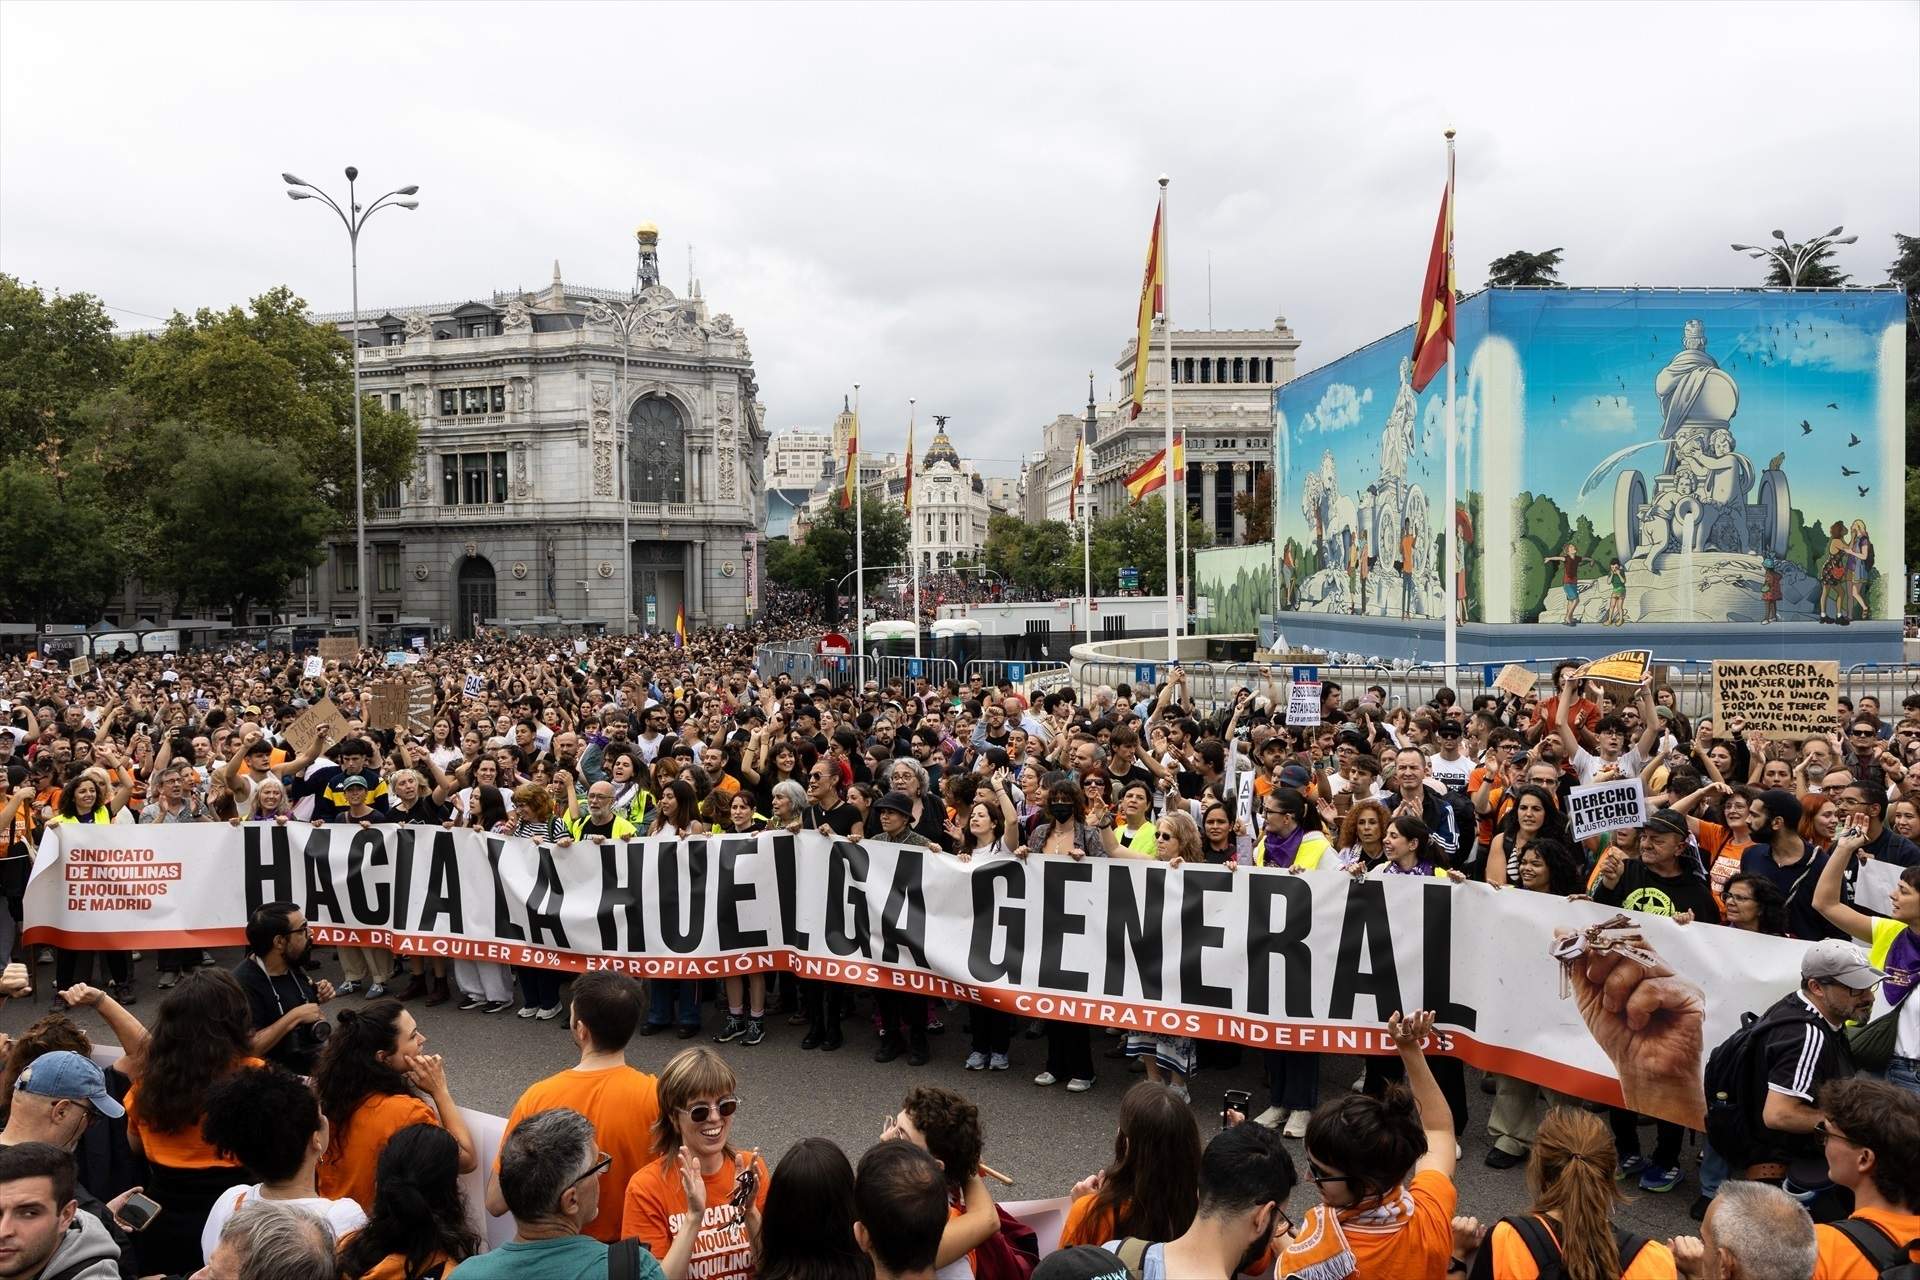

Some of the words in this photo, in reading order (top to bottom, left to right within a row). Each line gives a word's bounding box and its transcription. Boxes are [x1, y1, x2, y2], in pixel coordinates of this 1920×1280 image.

[1718, 665, 1748, 677] UNA
[1719, 679, 1739, 691] UN
[1788, 678, 1806, 688] UN
[1760, 690, 1768, 699] Y
[1770, 690, 1785, 698] LA
[1790, 688, 1830, 700] ÚNICA
[1722, 702, 1765, 712] FORMA
[1768, 702, 1784, 711] DE
[1787, 702, 1827, 712] TENER
[1816, 715, 1837, 724] QUE
[1782, 723, 1798, 732] MI
[1799, 725, 1838, 734] MADRE
[1572, 786, 1637, 812] DERECHO
[1575, 812, 1585, 827] A
[1585, 801, 1640, 823] TECHO
[1576, 826, 1583, 835] A
[1583, 820, 1608, 833] JUSTO
[1608, 815, 1641, 827] PRECIO!
[70, 848, 154, 862] SINDICATO
[69, 866, 90, 879] DE
[92, 865, 179, 881] INQUILINAS
[68, 884, 77, 896] E
[80, 883, 168, 896] INQUILINOS
[68, 899, 87, 911] DE
[90, 898, 152, 911] MADRID
[244, 826, 464, 934] HACIA
[487, 837, 571, 949] LA
[597, 835, 932, 970] HUELGA
[968, 859, 1477, 1033] GENERAL
[400, 938, 511, 961] ALQUILER
[521, 948, 561, 967] 50%
[586, 953, 774, 975] EXPROPIACIÓN
[788, 953, 880, 982] FONDOS
[892, 972, 981, 1001] BUITRE
[1015, 995, 1201, 1032] CONTRATOS
